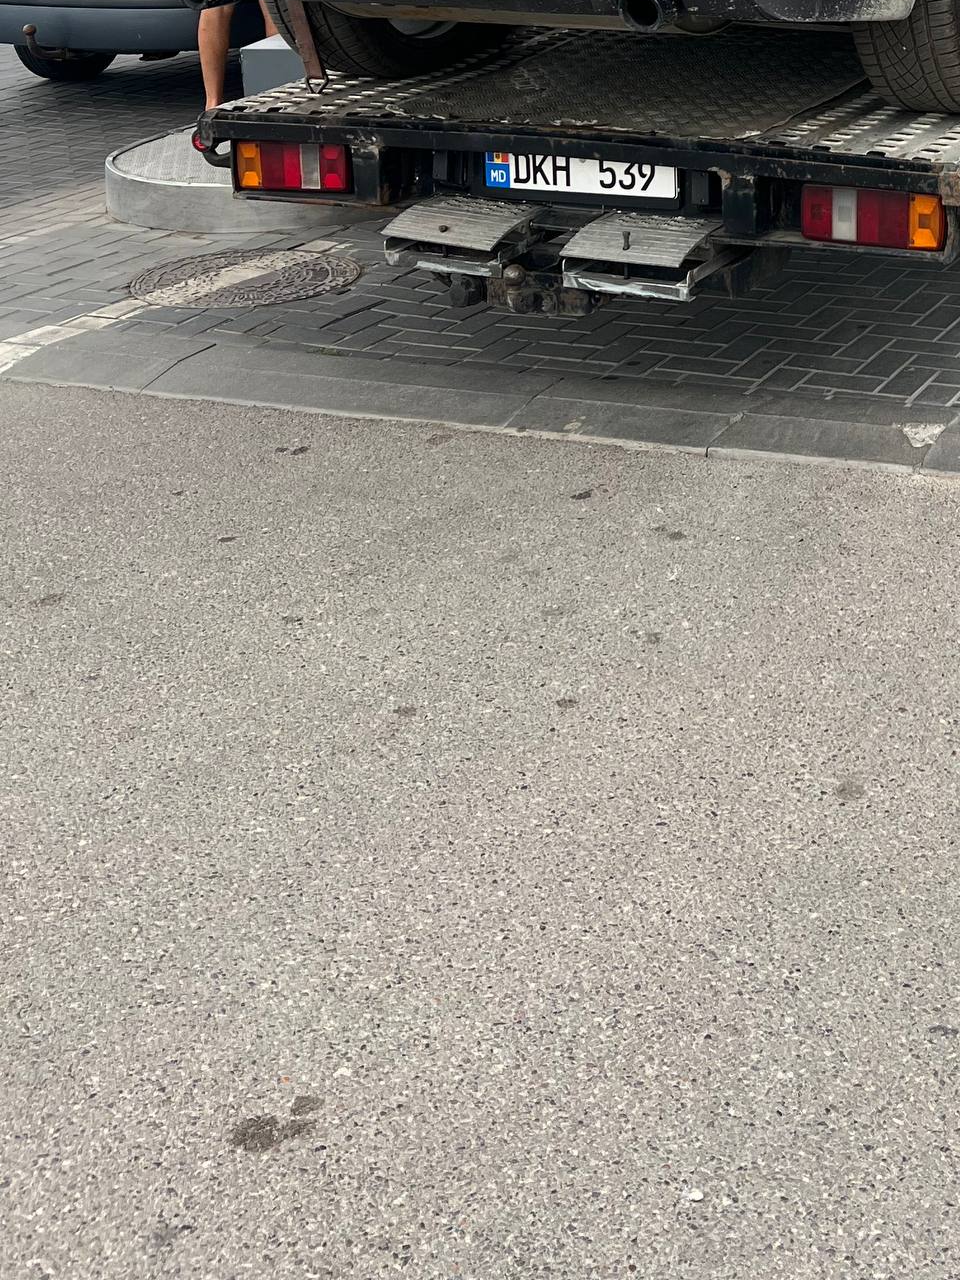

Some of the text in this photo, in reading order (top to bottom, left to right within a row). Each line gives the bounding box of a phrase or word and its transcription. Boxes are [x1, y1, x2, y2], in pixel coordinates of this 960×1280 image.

[490, 154, 655, 191] MD DKH 539
